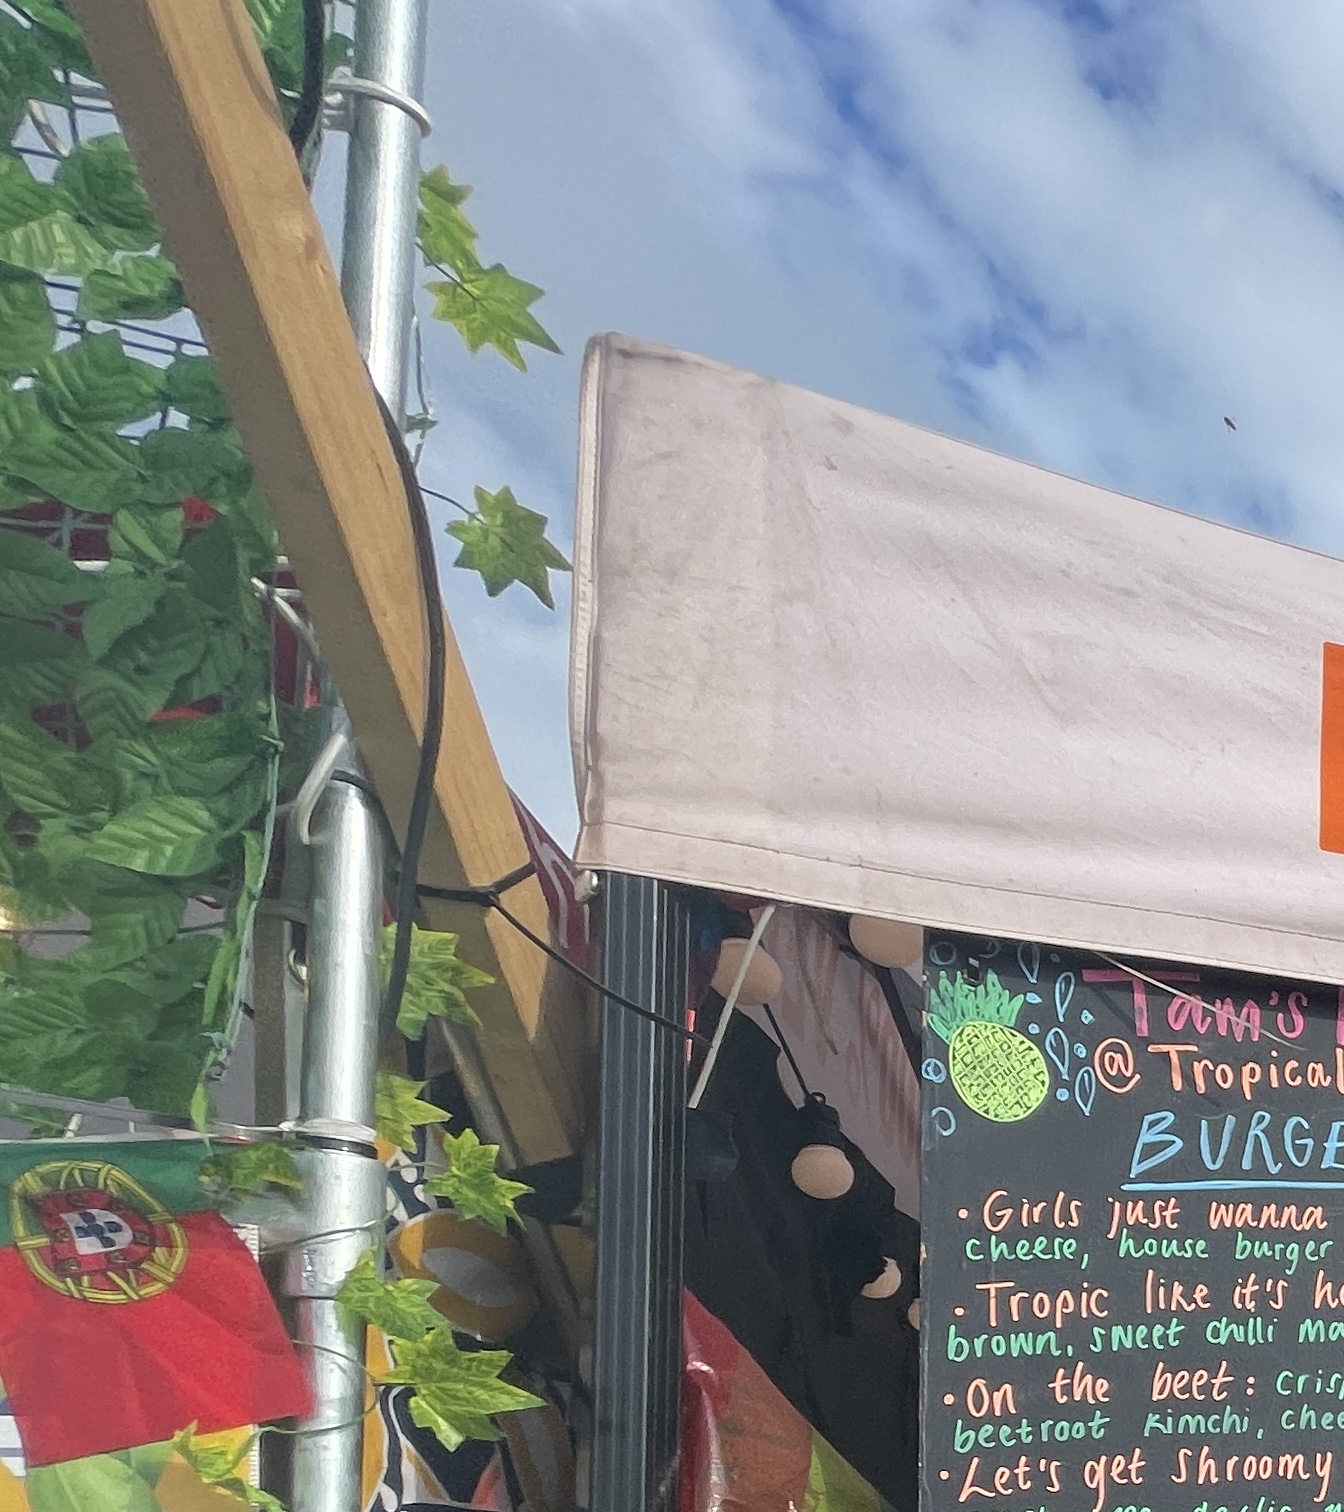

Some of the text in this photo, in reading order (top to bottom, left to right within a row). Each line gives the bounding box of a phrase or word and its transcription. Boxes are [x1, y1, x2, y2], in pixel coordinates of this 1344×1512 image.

[1081, 964, 1304, 1046] Tam's
[984, 1191, 1081, 1231] Girls
[1107, 1197, 1180, 1238] just
[1210, 1202, 1327, 1231] wanna
[1119, 1228, 1208, 1258] house
[1236, 1232, 1333, 1275] burger
[976, 1282, 1108, 1328] Tropic
[1146, 1269, 1211, 1313] like
[1234, 1273, 1288, 1312] it's
[1206, 1317, 1273, 1345] chilli
[967, 1379, 1016, 1417] On
[1048, 1361, 1109, 1404] the
[954, 1410, 1110, 1453] beetroot
[959, 1456, 1061, 1502] Let's
